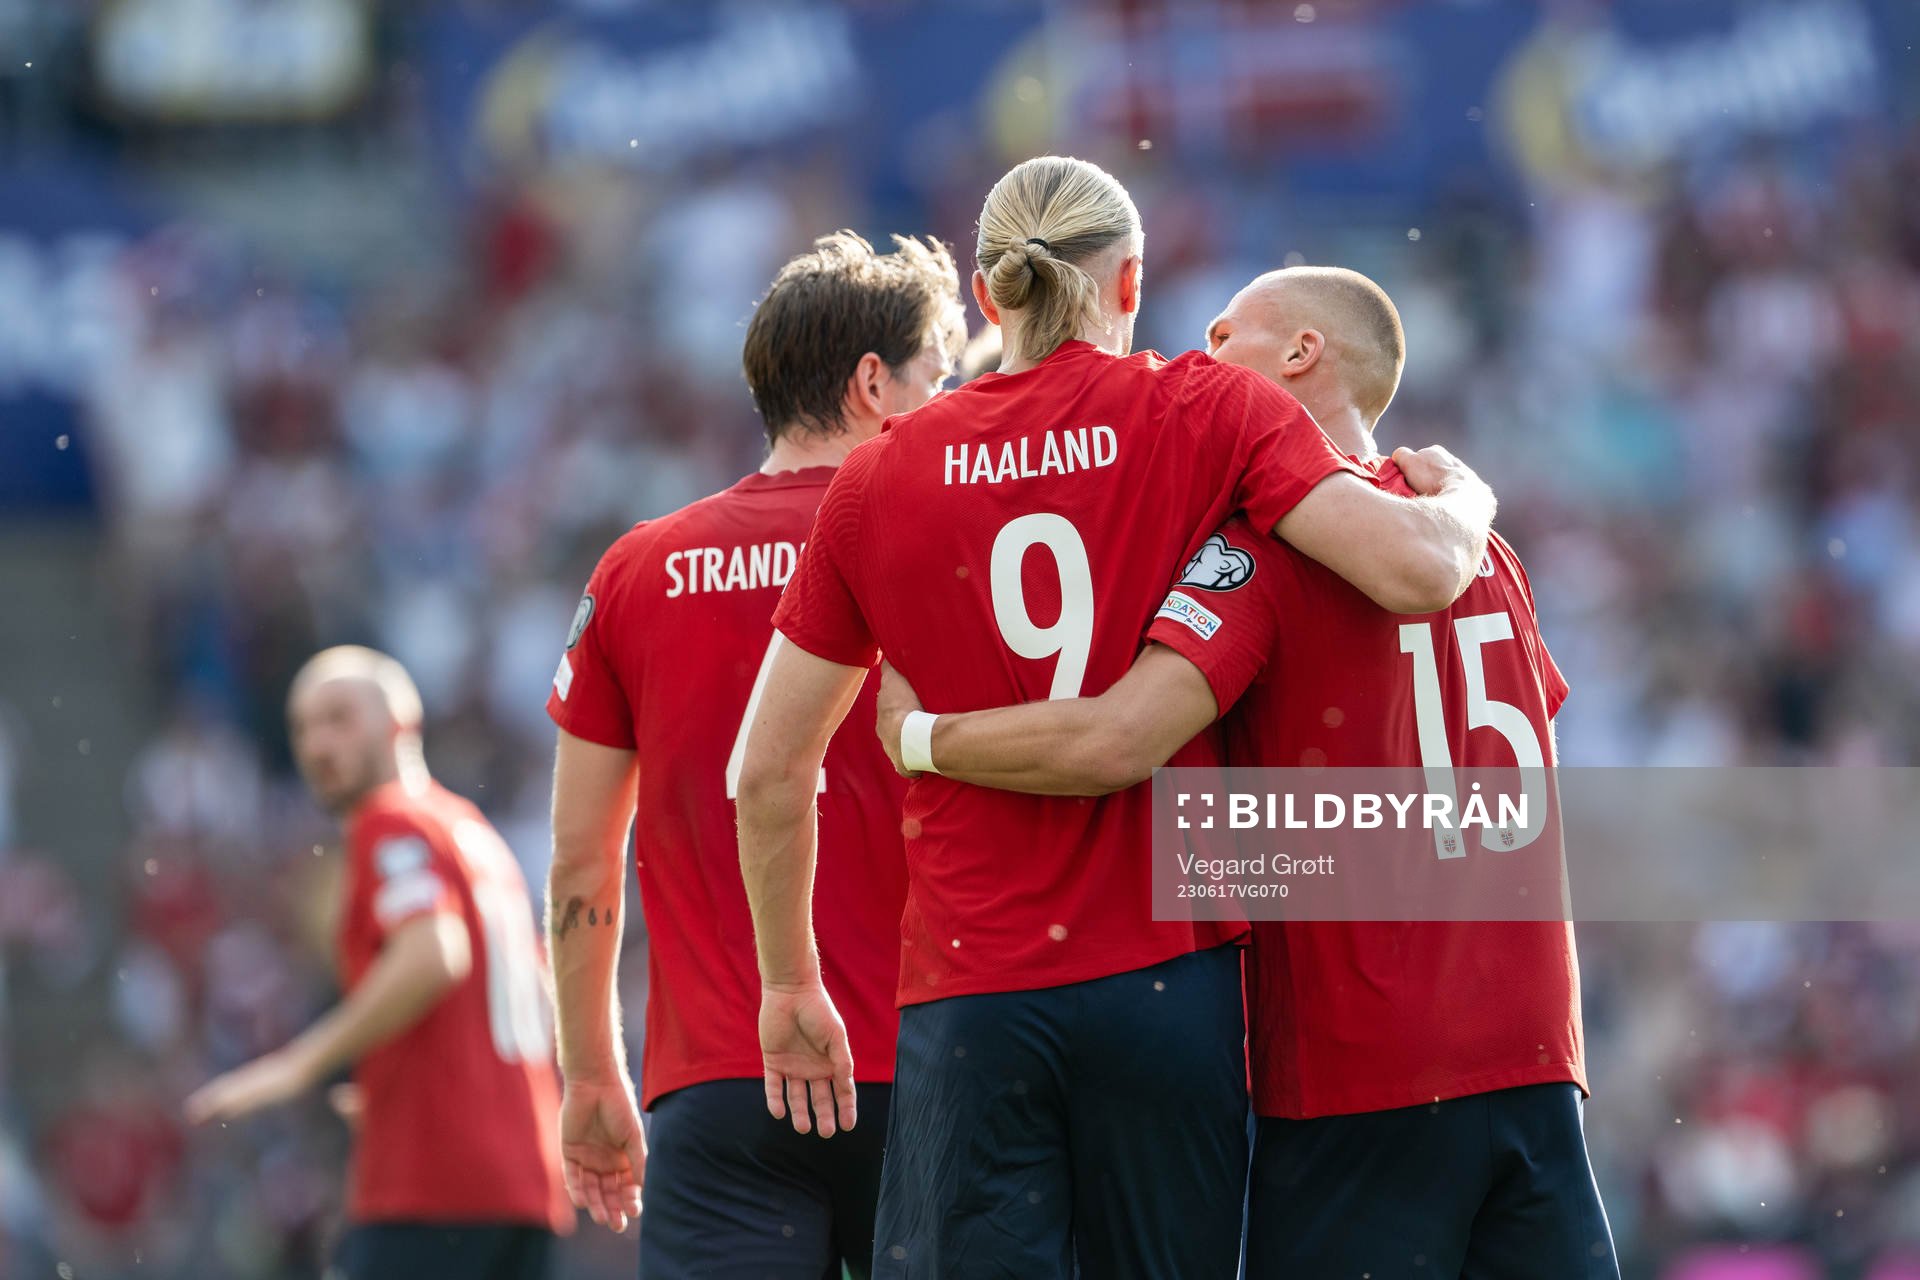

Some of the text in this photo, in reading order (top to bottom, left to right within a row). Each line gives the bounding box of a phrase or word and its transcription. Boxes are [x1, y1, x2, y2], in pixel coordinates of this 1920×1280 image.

[945, 425, 1117, 485] HAALAND
[665, 541, 806, 598] STRAND
[990, 512, 1094, 701] 9
[1163, 598, 1217, 632] NDATION
[1398, 611, 1548, 860] 15
